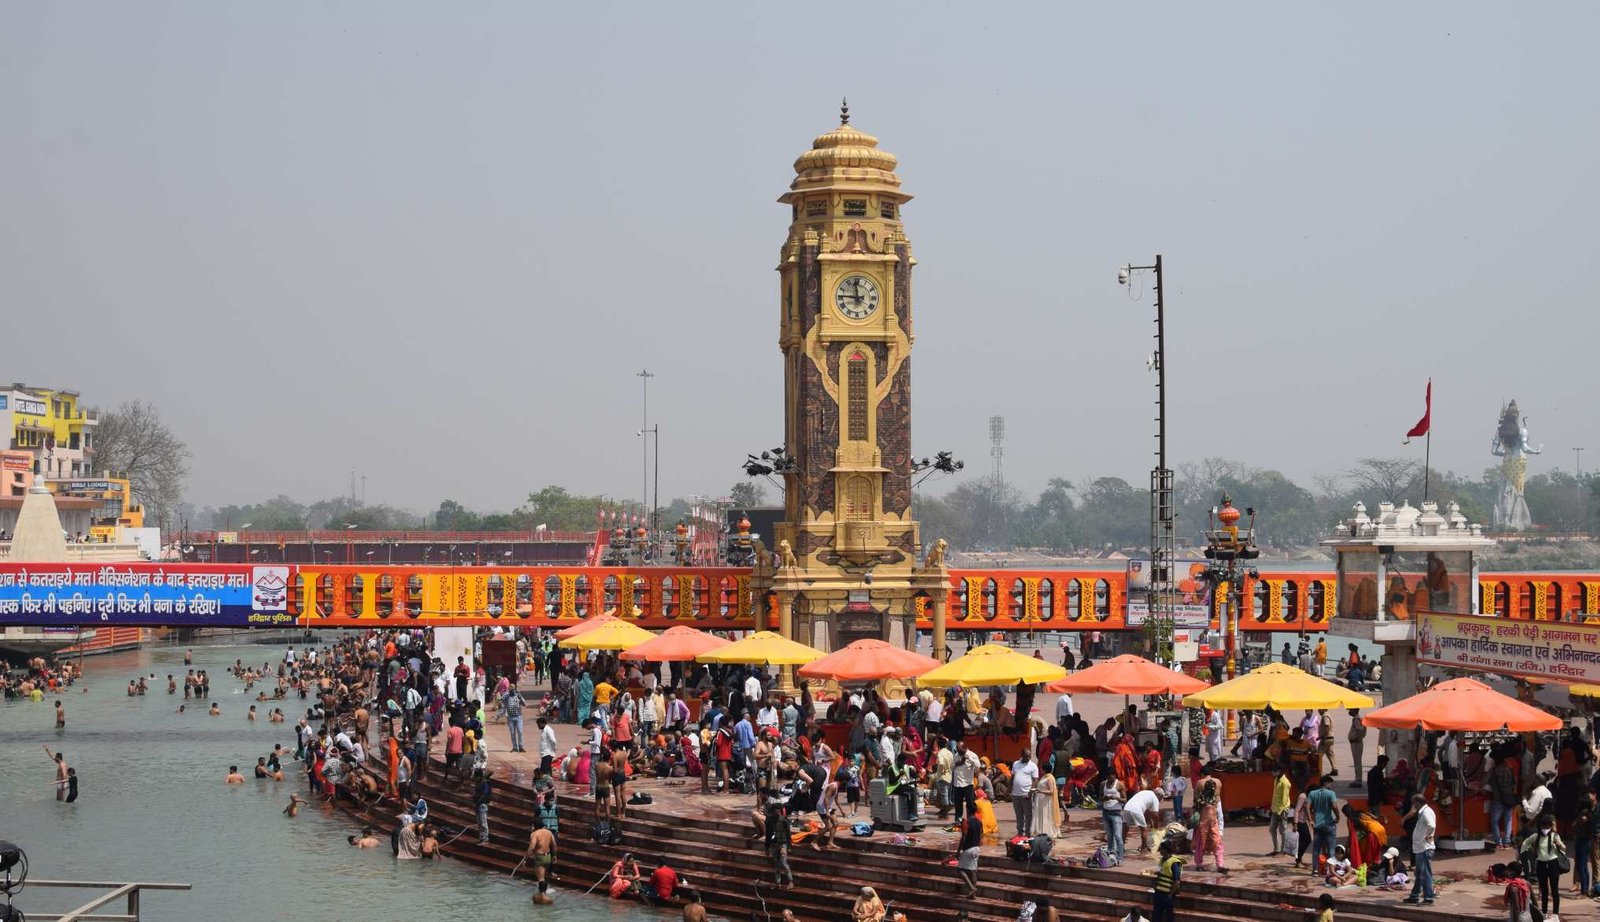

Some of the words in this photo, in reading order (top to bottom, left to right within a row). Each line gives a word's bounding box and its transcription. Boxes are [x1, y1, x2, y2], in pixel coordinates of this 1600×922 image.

[18, 568, 28, 588] से
[30, 568, 72, 589] कतराइये
[153, 567, 164, 587] के
[166, 573, 185, 587] बाद
[22, 593, 41, 614] फिर
[43, 593, 56, 614] भी
[98, 593, 114, 620] दूरी
[117, 593, 137, 614] फिर
[139, 593, 151, 614] भी
[153, 599, 173, 614] बना
[175, 594, 186, 614] के
[1441, 636, 1469, 650] आपका
[1470, 635, 1499, 653] हार्दिक
[1501, 642, 1533, 657] स्वागत
[1534, 641, 1550, 660] एवं
[1541, 630, 1580, 642] आगमन
[1583, 633, 1598, 644] पर
[1457, 653, 1468, 662] श्री
[1470, 655, 1491, 665] गंगा
[1493, 659, 1513, 668] सभा
[1549, 663, 1586, 676] हरिद्वार
